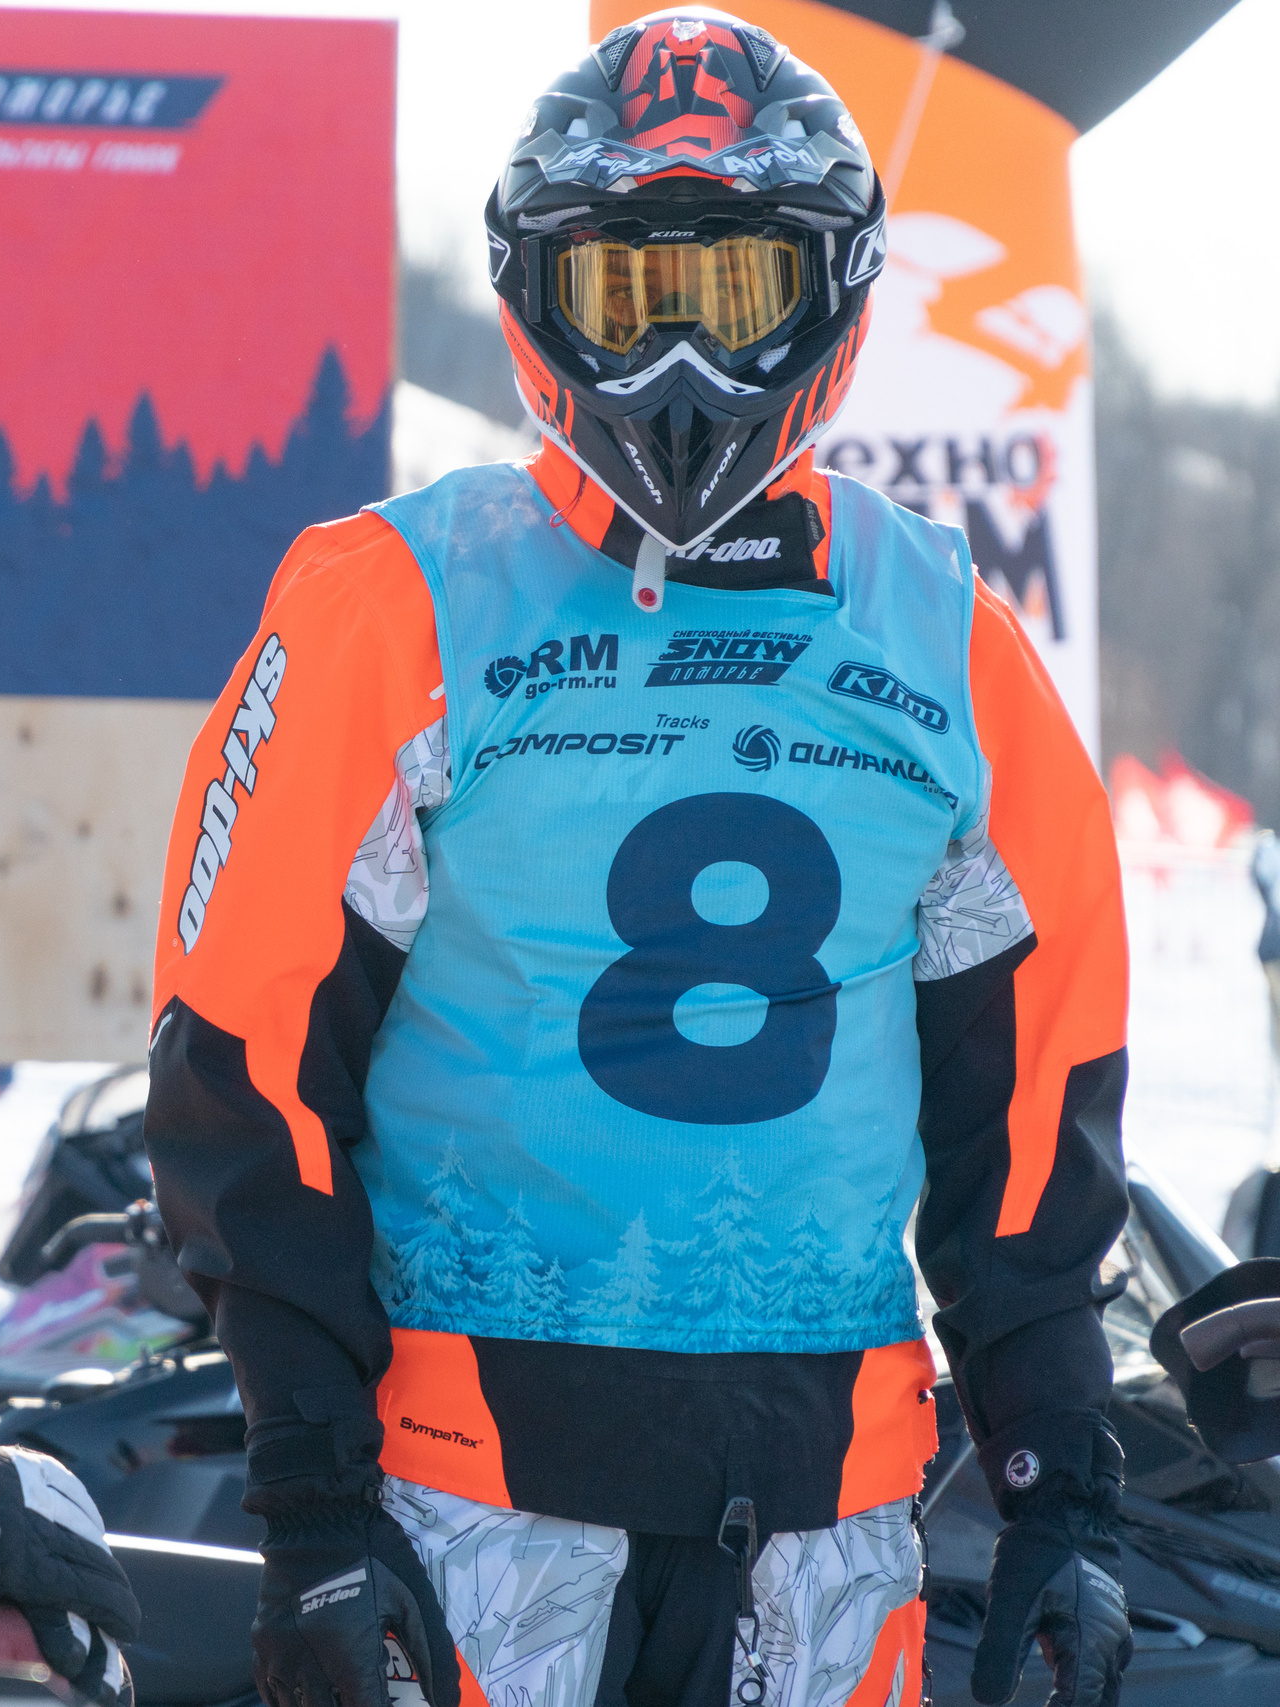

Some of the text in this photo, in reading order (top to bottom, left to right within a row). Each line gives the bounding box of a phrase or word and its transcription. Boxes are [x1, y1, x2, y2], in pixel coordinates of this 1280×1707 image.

[624, 440, 663, 505] Airoh
[700, 440, 738, 509] Airoh
[666, 536, 781, 563] i-doo
[660, 637, 811, 663] SNOW
[672, 629, 813, 643] СНЕГОХОДНЫЙ ФЕСТИВАЛЬ
[524, 671, 617, 700] go-rm.ru
[670, 665, 764, 682] ПОМОРЬЕ
[656, 713, 710, 730] Tracks
[474, 733, 686, 771] COMPOSIT
[577, 791, 843, 1126] 8
[300, 1585, 362, 1615] ski-doo
